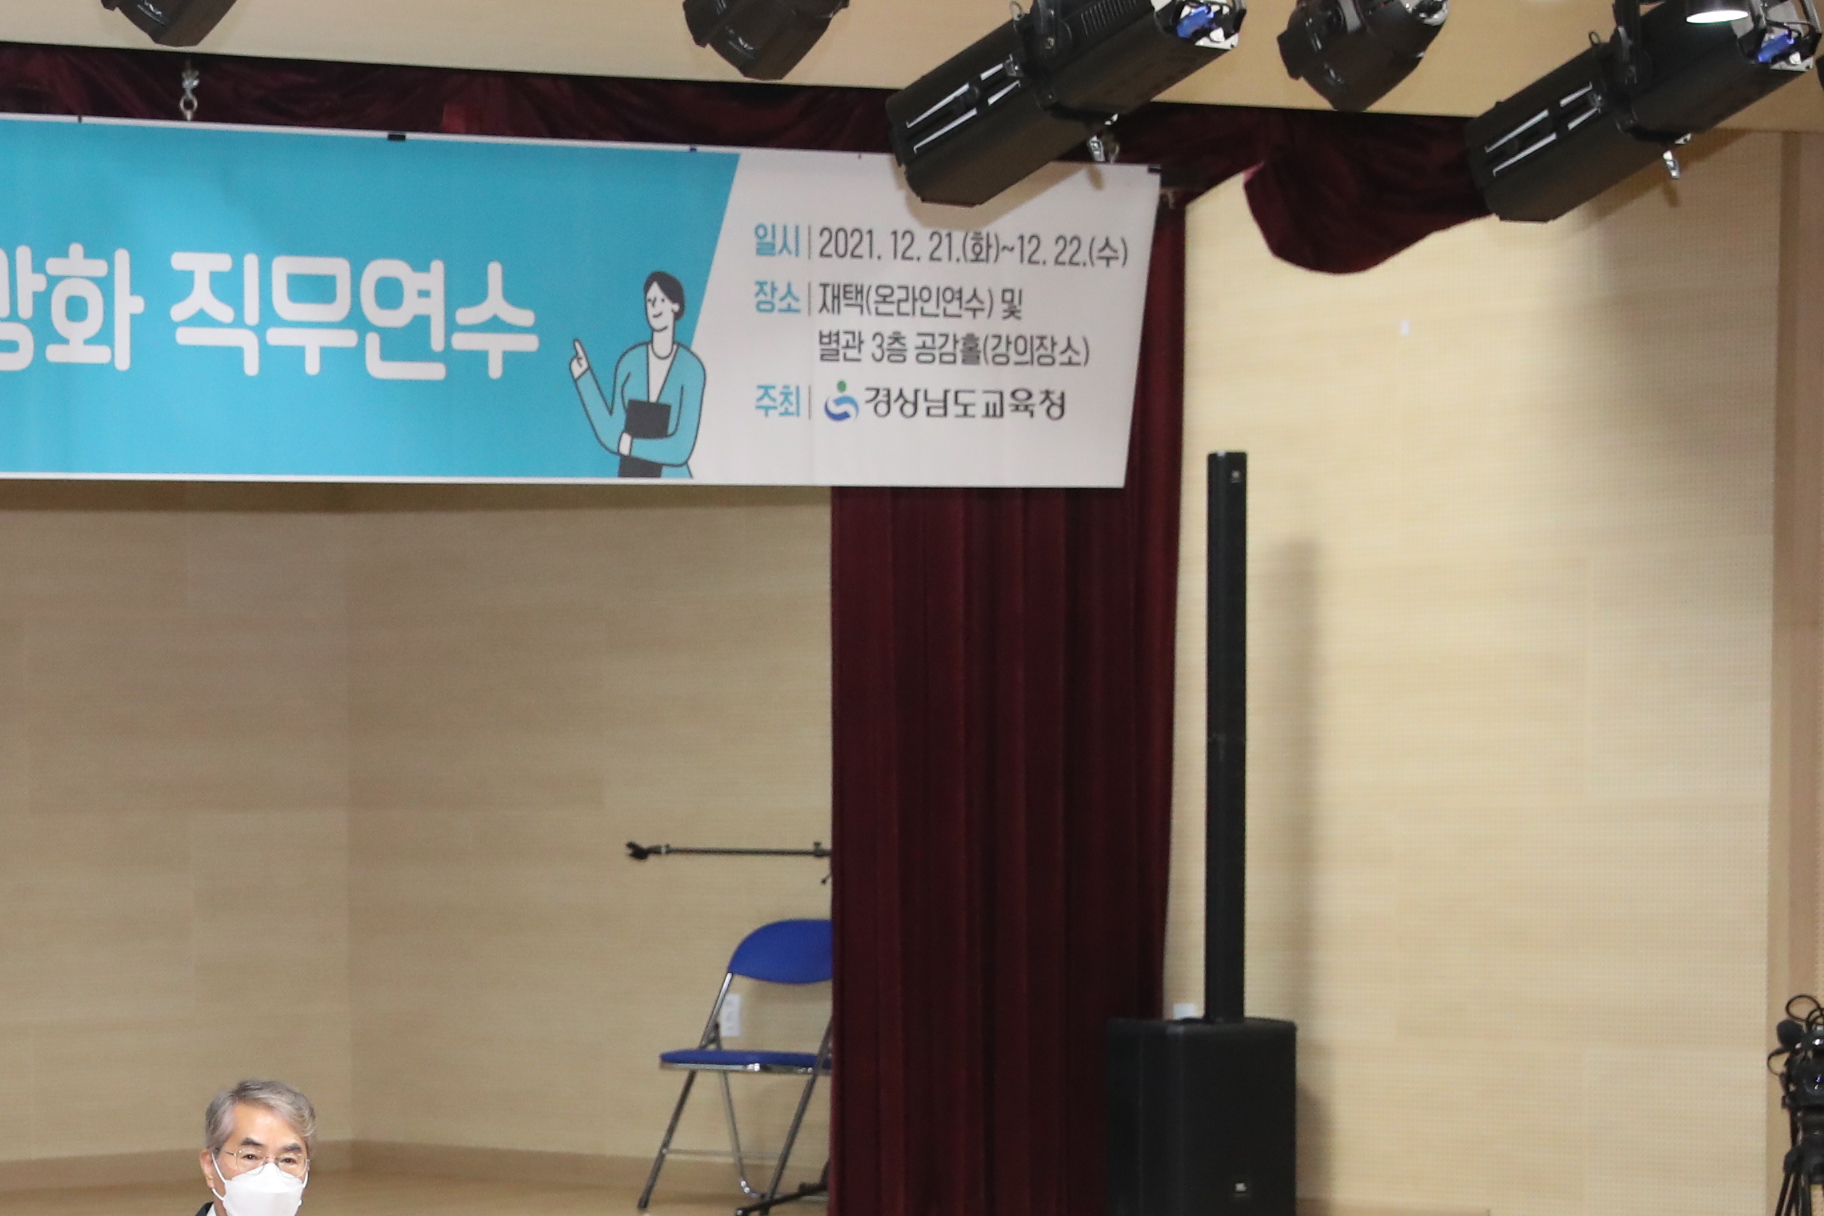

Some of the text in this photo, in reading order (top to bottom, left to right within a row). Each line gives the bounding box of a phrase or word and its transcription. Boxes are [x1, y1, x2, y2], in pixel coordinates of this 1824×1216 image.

[754, 223, 801, 259] 일시
[819, 227, 882, 261] 2021.
[890, 230, 922, 262] 12.
[1053, 236, 1129, 268] 22.(수)
[169, 251, 540, 381] 직무연수
[754, 280, 802, 315] 장소
[818, 282, 1024, 321] 재택(온라인연수) 및
[818, 330, 1091, 368] 별관 3층 공감홀(강의장소)
[754, 384, 802, 419] 주최
[864, 386, 1067, 421] 경상남도교육청
